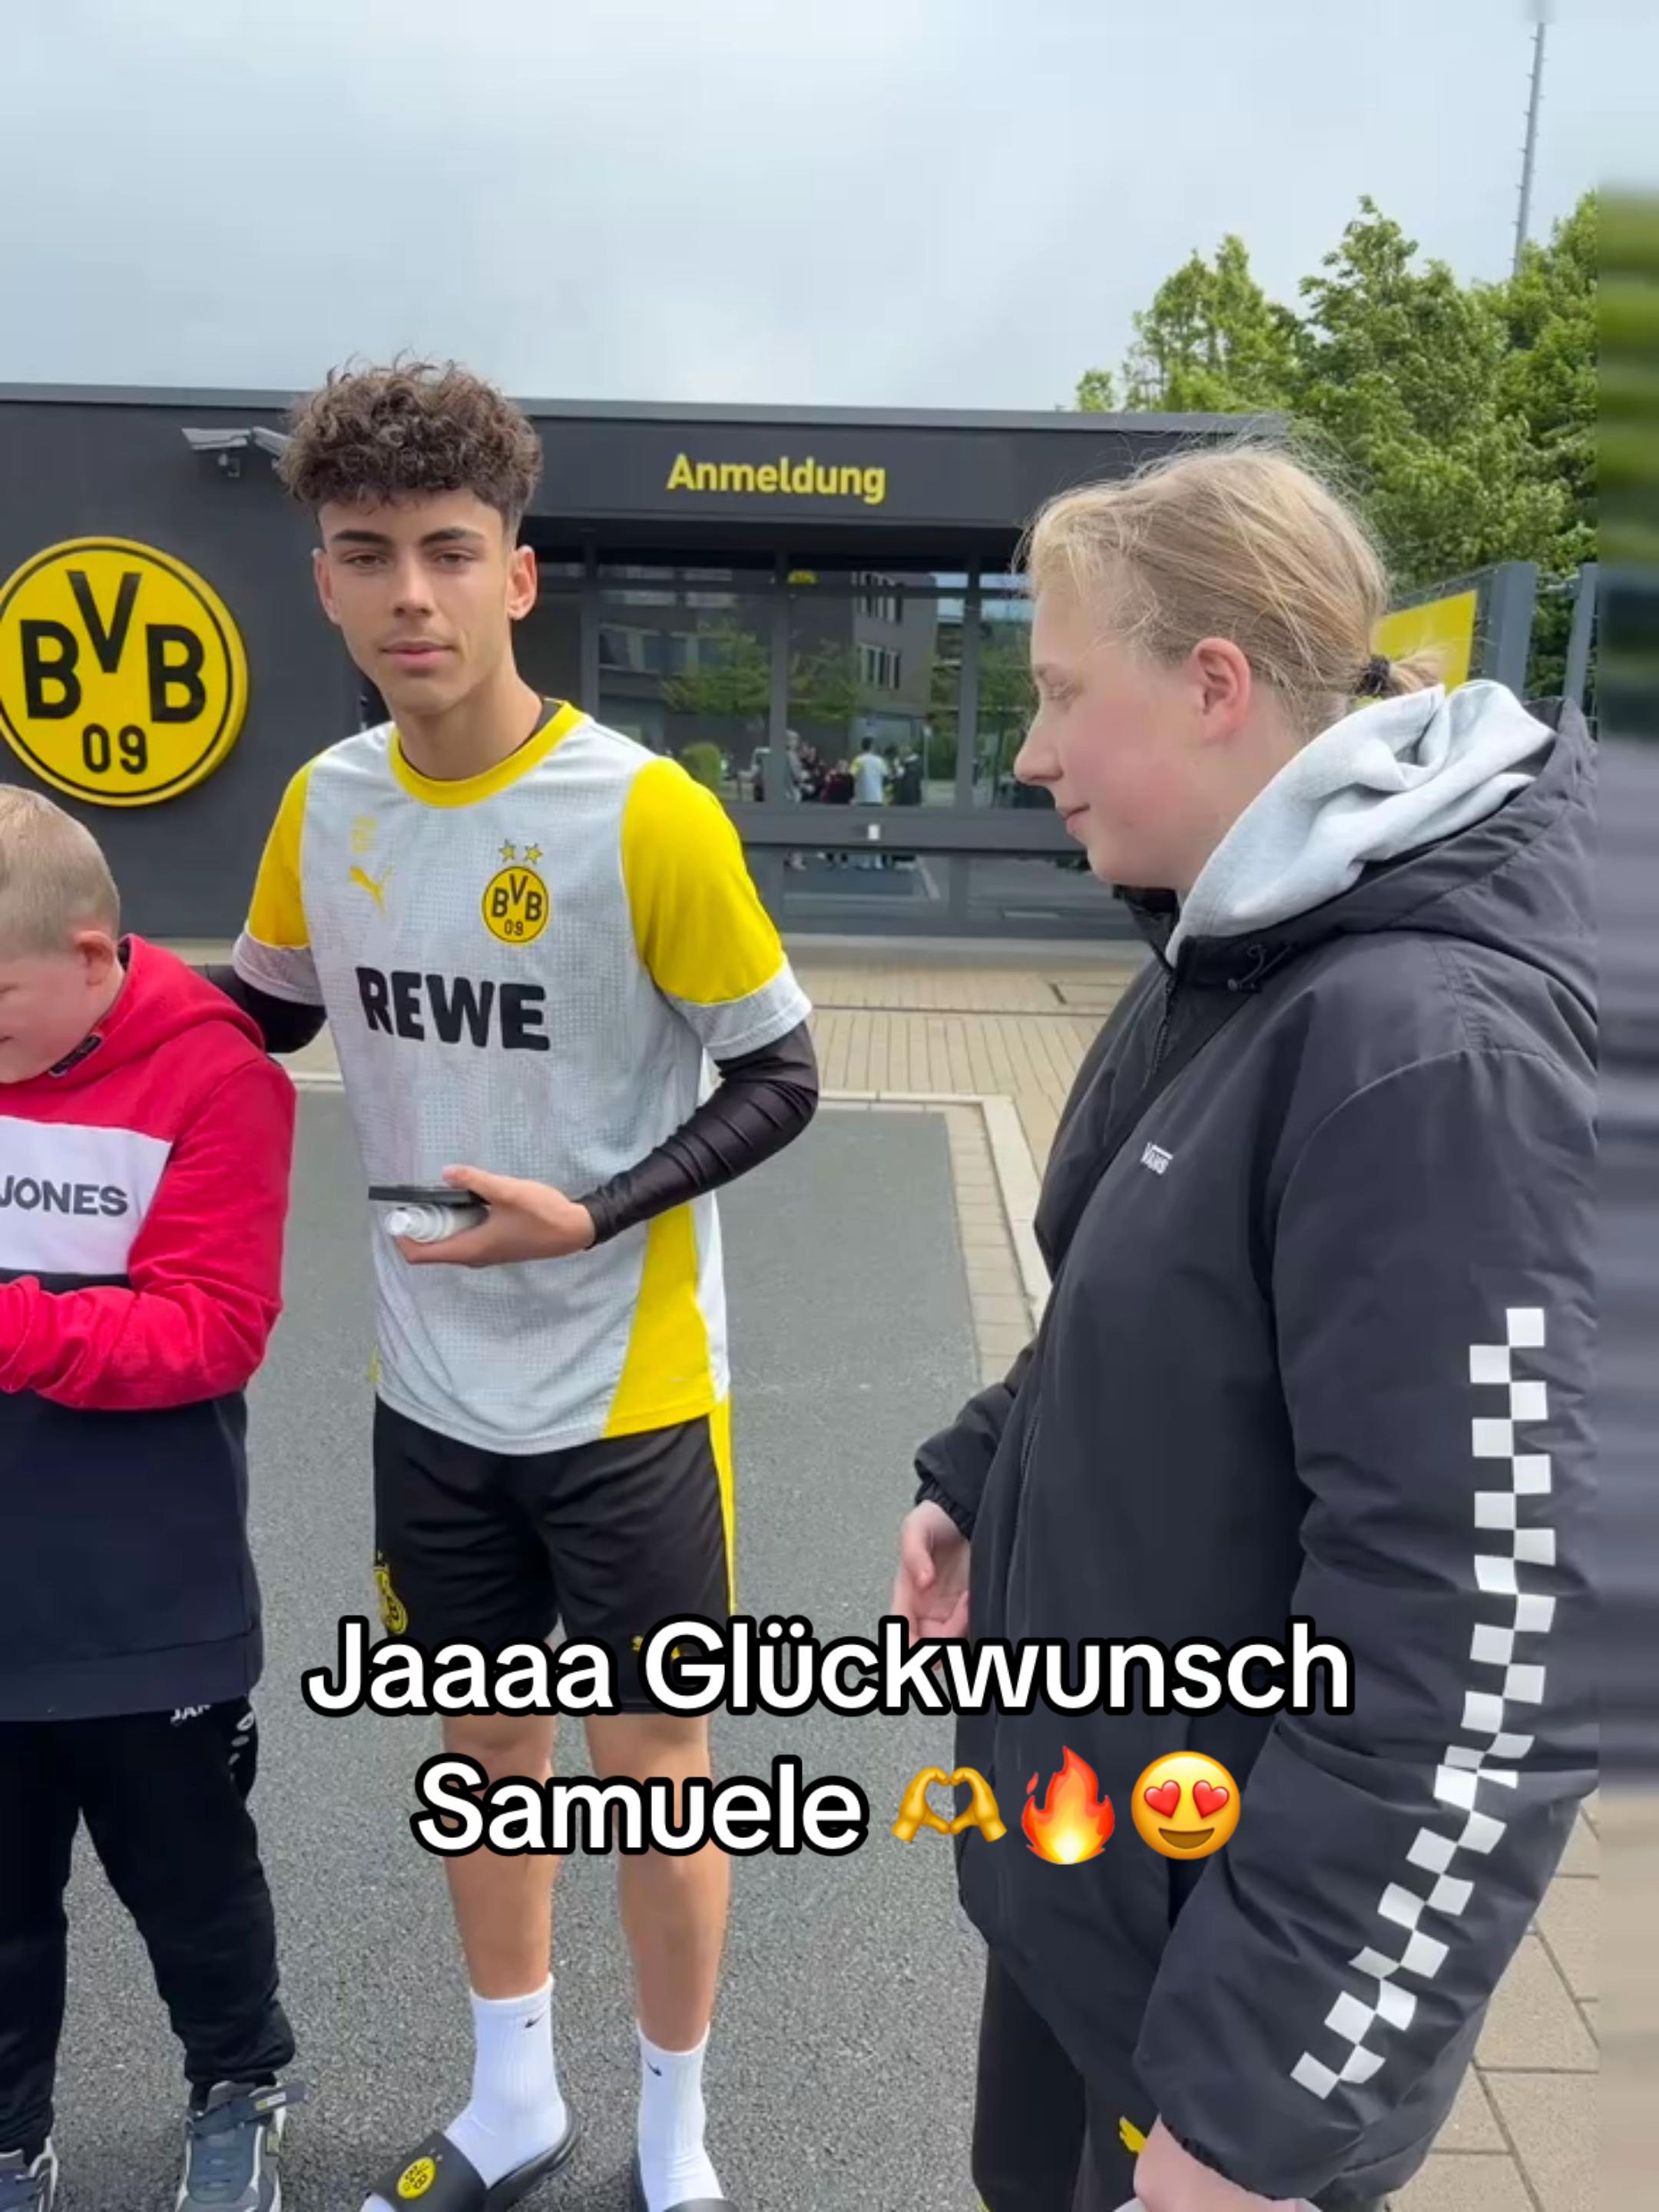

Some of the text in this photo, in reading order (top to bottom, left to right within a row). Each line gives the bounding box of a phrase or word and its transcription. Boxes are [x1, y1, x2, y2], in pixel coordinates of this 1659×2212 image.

[667, 454, 886, 505] Anmeldung
[20, 571, 206, 724] BVB
[83, 724, 147, 773] 09
[492, 874, 542, 921] BVB
[505, 920, 524, 935] 09
[356, 966, 550, 1051] REWE
[0, 1175, 128, 1217] JONES
